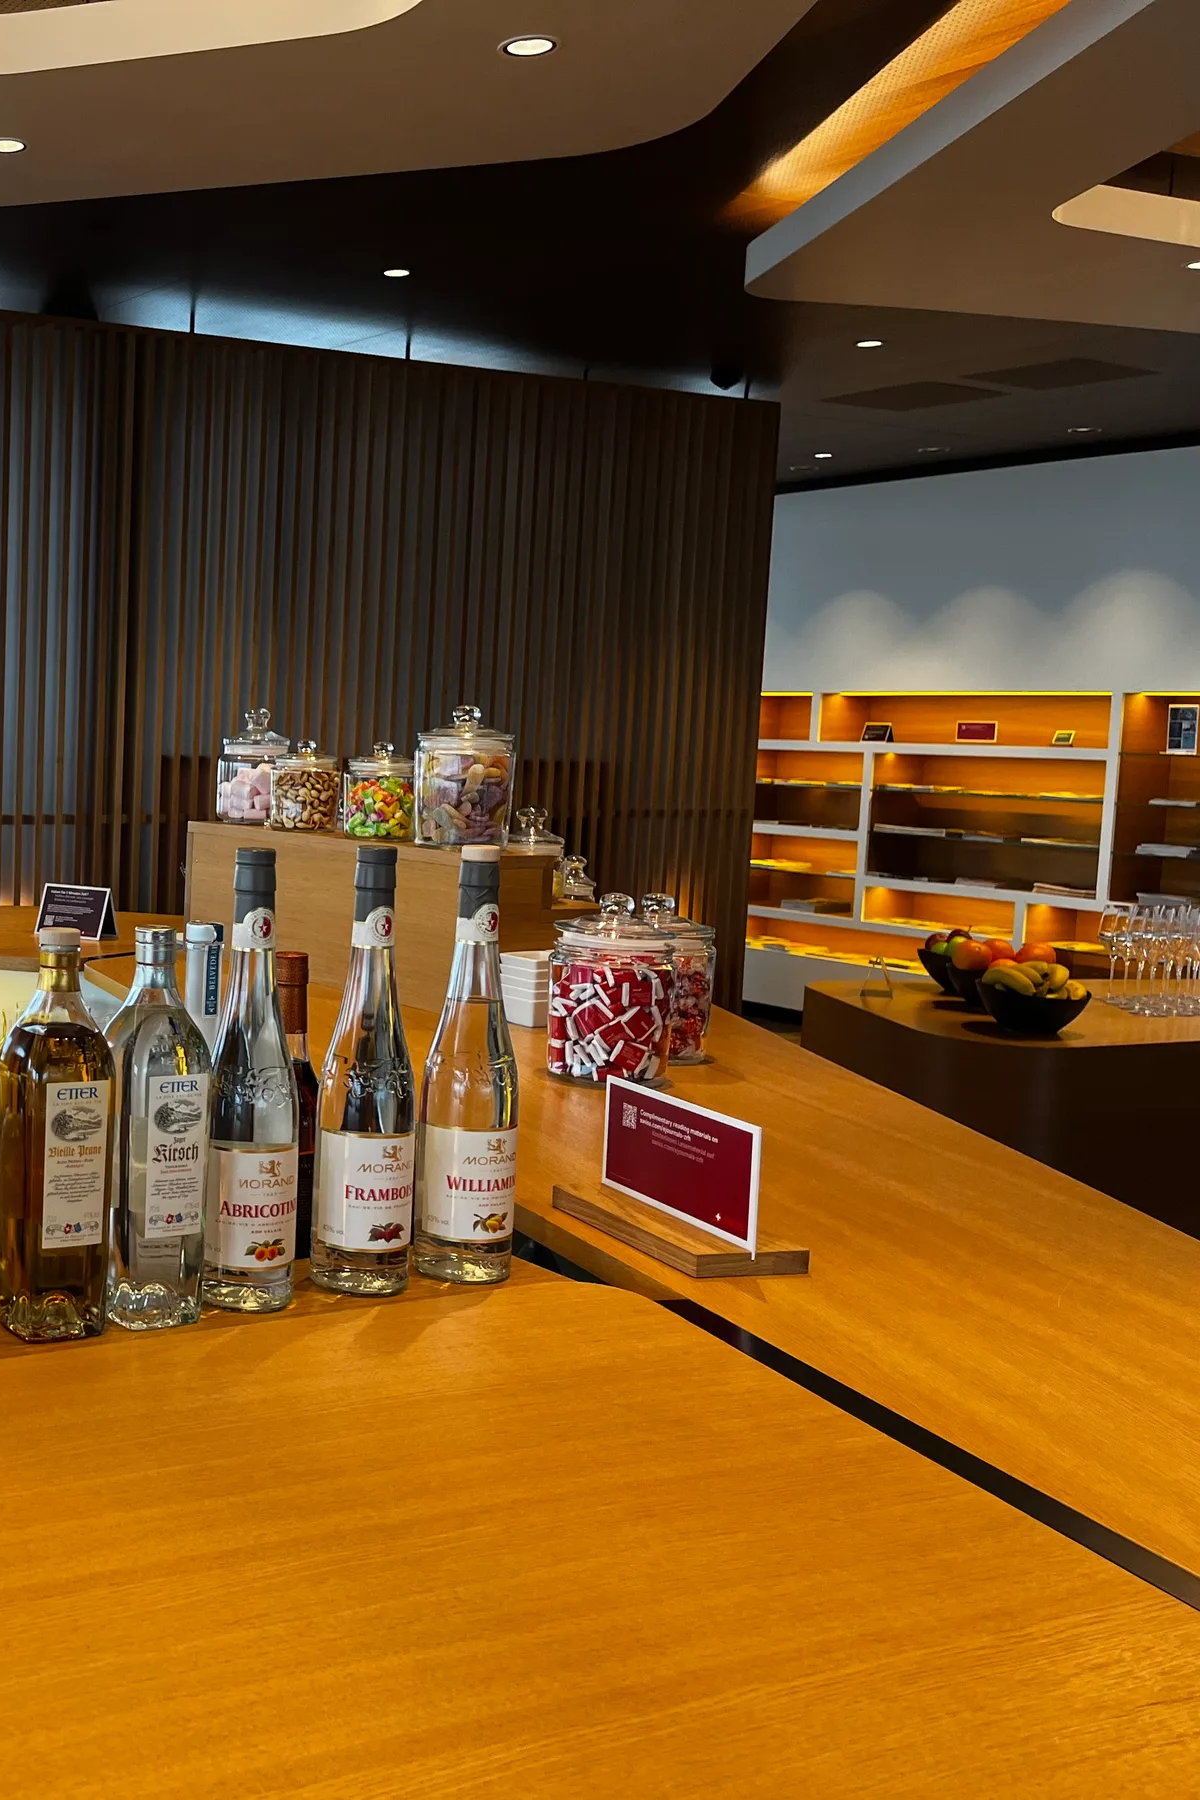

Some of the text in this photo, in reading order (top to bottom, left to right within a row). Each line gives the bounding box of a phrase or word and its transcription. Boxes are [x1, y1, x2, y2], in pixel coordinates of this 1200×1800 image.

[57, 1086, 98, 1100] ETTER
[160, 1080, 199, 1094] ETTER
[640, 1109, 672, 1127] Complimentary
[673, 1122, 690, 1134] reading
[152, 1141, 199, 1164] Kirsch
[462, 1152, 516, 1165] MORAND
